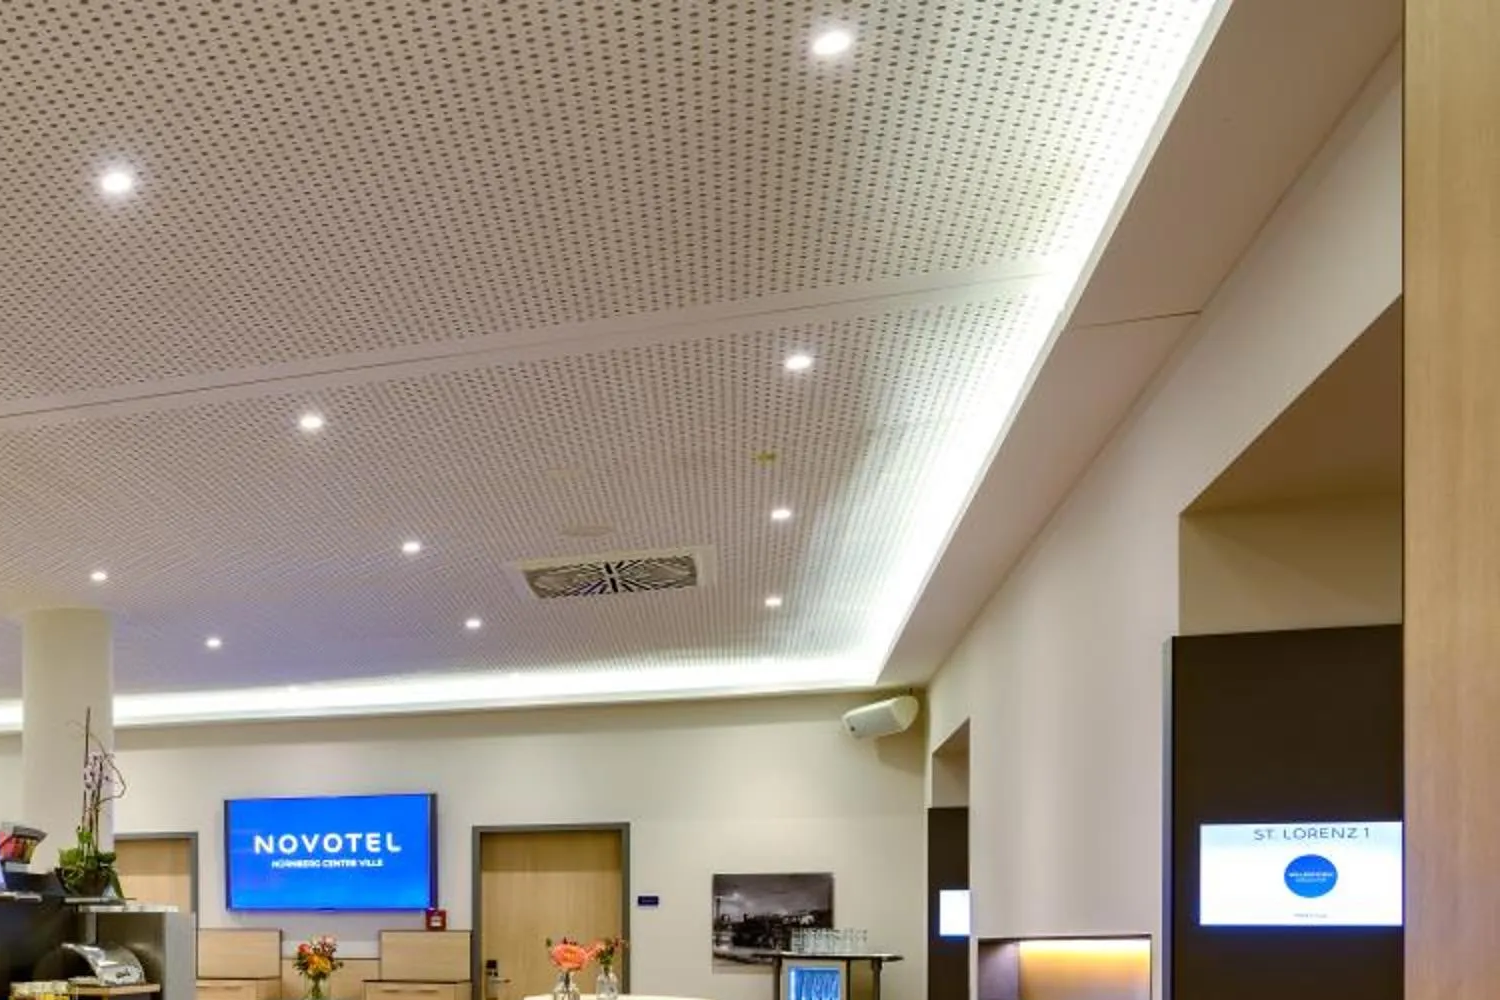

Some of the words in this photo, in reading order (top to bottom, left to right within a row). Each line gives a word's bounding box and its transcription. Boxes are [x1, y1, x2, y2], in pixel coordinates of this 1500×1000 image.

[1283, 827, 1358, 840] LORENZ
[1363, 827, 1370, 838] 1
[254, 832, 402, 854] NOVOTEL
[359, 857, 384, 868] VILLE
